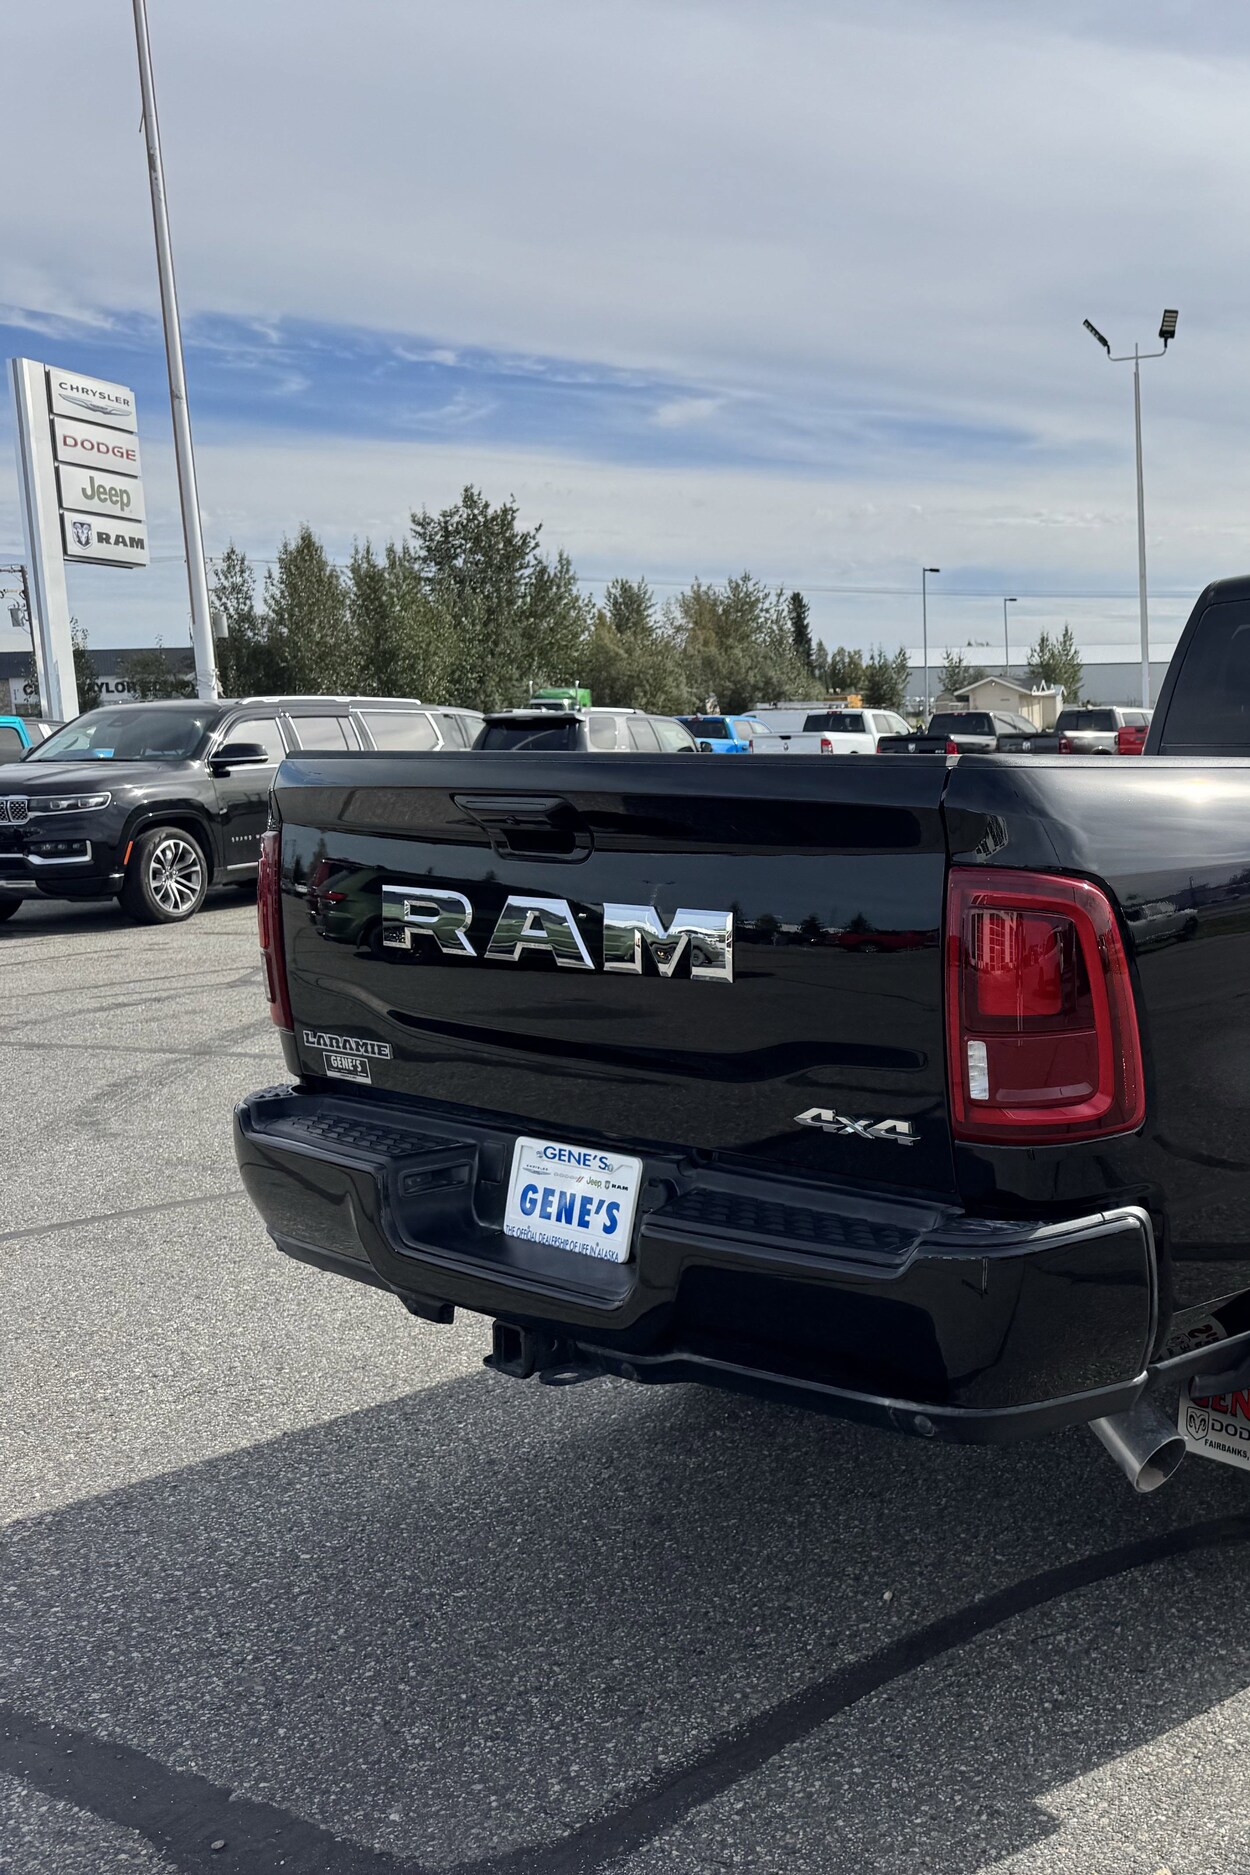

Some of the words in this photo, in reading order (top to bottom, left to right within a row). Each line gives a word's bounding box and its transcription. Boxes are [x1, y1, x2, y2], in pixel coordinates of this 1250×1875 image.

[58, 382, 130, 407] CHRYSLER
[63, 434, 136, 461] DODGE
[81, 475, 131, 511] Jeep
[97, 531, 145, 550] RAM
[382, 884, 735, 984] RAM
[302, 1030, 393, 1059] LARAMIE
[330, 1055, 362, 1072] GENE'S
[543, 1146, 609, 1171] GENE'S
[586, 1176, 602, 1189] Jeep
[611, 1183, 629, 1192] RAM
[519, 1183, 621, 1235] GENE'S
[505, 1224, 516, 1236] THE
[570, 1240, 578, 1252] OF
[578, 1242, 590, 1255] LIFE
[597, 1247, 619, 1262] ALASKA
[1204, 1438, 1250, 1461] FAIRBANKS,
